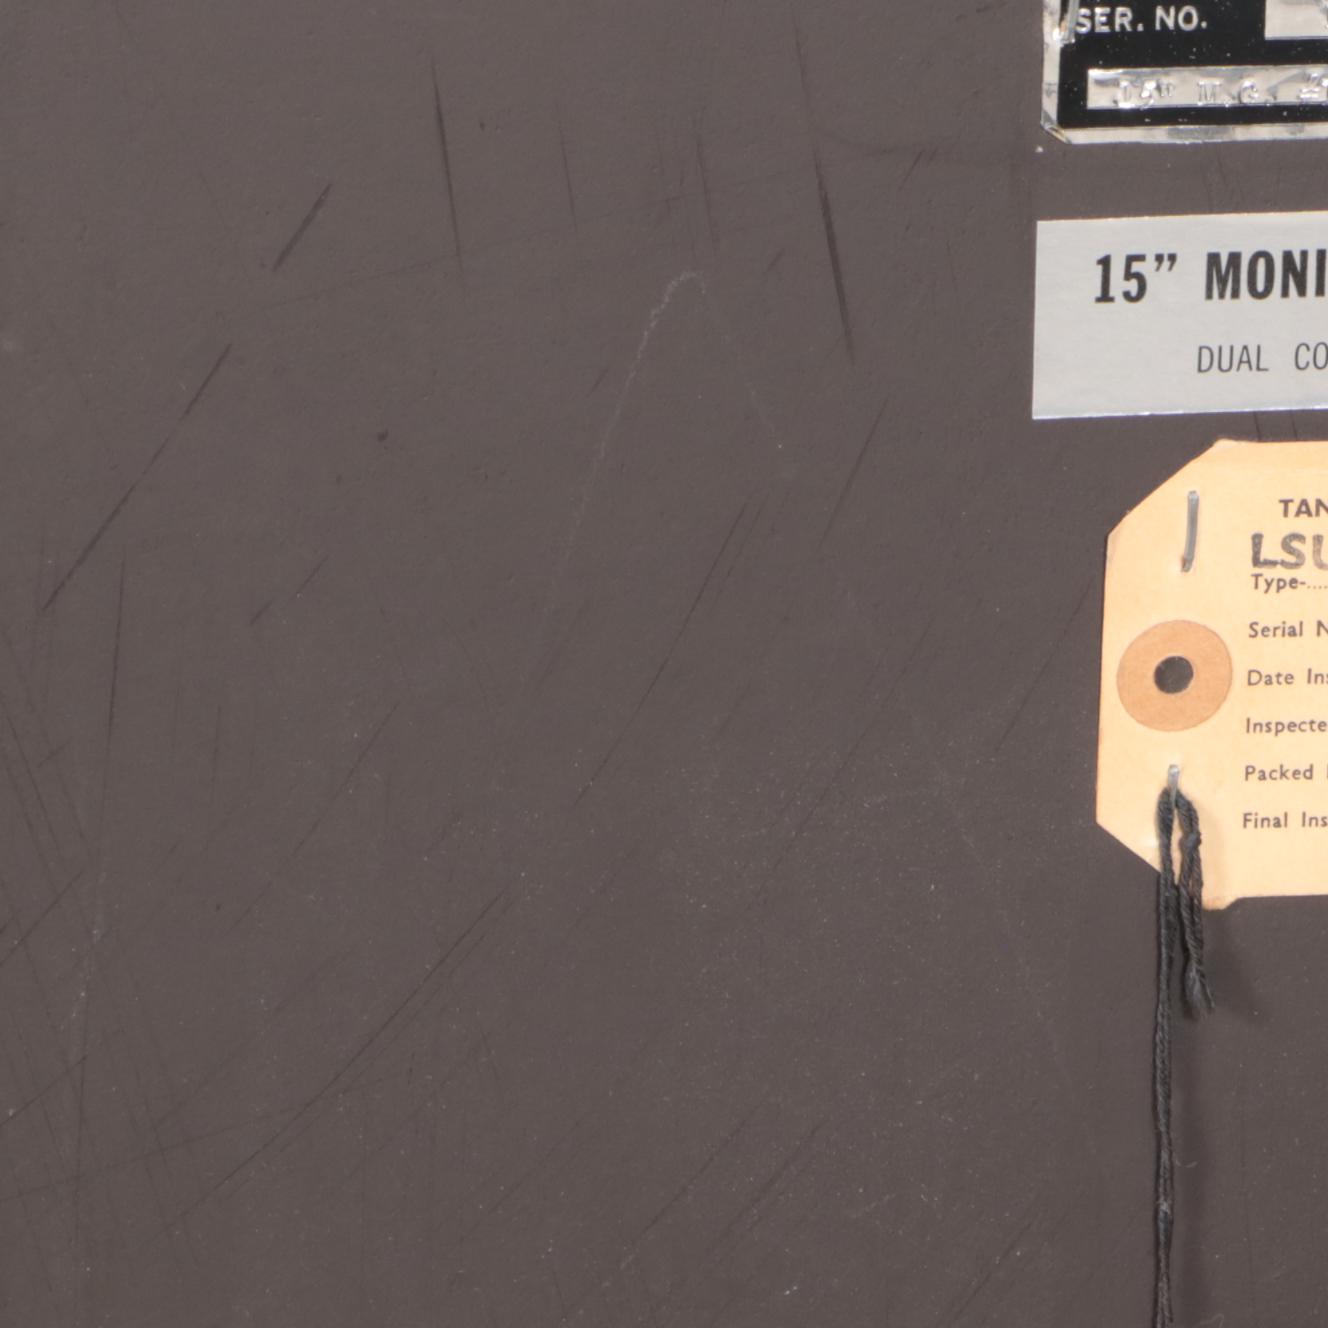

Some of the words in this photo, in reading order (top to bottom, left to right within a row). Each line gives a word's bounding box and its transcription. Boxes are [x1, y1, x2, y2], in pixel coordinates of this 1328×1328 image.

[1074, 7, 1144, 35] SER.
[1154, 4, 1208, 33] NO.
[1197, 344, 1270, 374] DUAL
[1248, 622, 1303, 639] Serial
[1247, 670, 1295, 686] Date
[1245, 764, 1314, 782] Packed
[1242, 813, 1288, 829] Final
